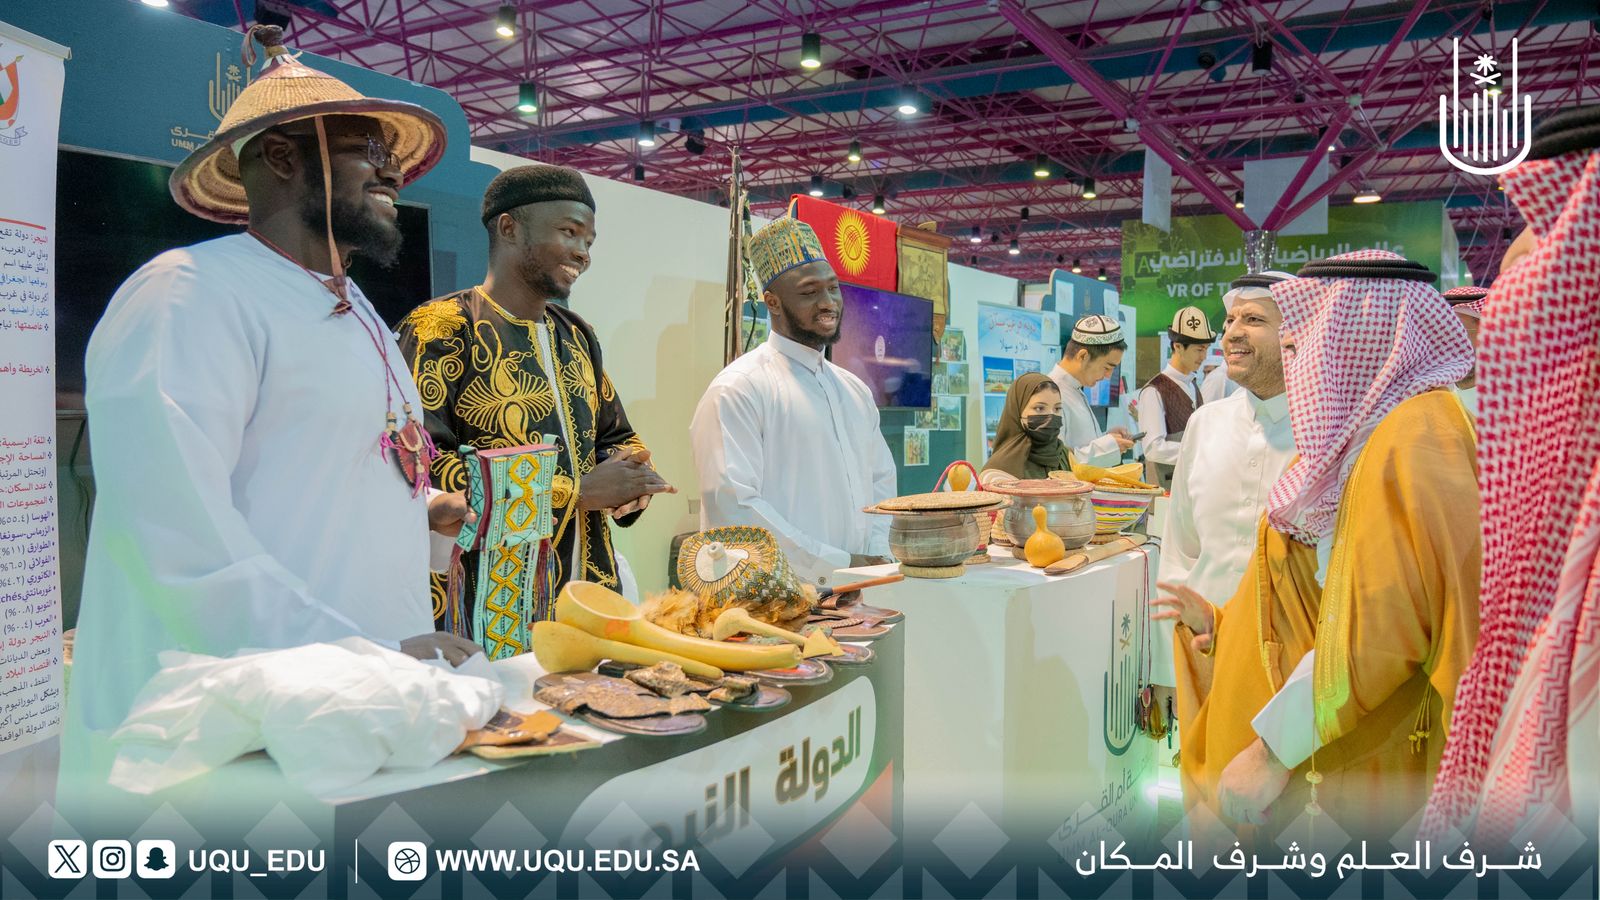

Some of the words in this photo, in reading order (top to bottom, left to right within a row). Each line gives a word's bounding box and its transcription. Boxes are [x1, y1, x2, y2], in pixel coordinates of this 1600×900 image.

[15, 229, 28, 241] دولة
[27, 249, 36, 258] من
[20, 290, 27, 303] في
[1166, 284, 1188, 298] VR
[1190, 282, 1214, 297] OF
[19, 363, 44, 377] الخريطة
[19, 452, 46, 462] المساحة
[7, 496, 48, 510] المجموعات
[32, 510, 50, 523] الهوسا
[28, 540, 51, 553] الطوارق
[29, 555, 52, 570] الفولاني
[27, 570, 52, 586] الكانوري
[35, 615, 53, 628] العرب
[9, 637, 27, 649] دولة
[30, 630, 50, 646] النيجر
[31, 647, 50, 660] وبعض
[28, 659, 50, 673] اقتصاد
[5, 667, 26, 680] البلاد
[15, 711, 38, 725] سادس
[26, 720, 46, 735] الدولة
[775, 705, 861, 806] الدولة
